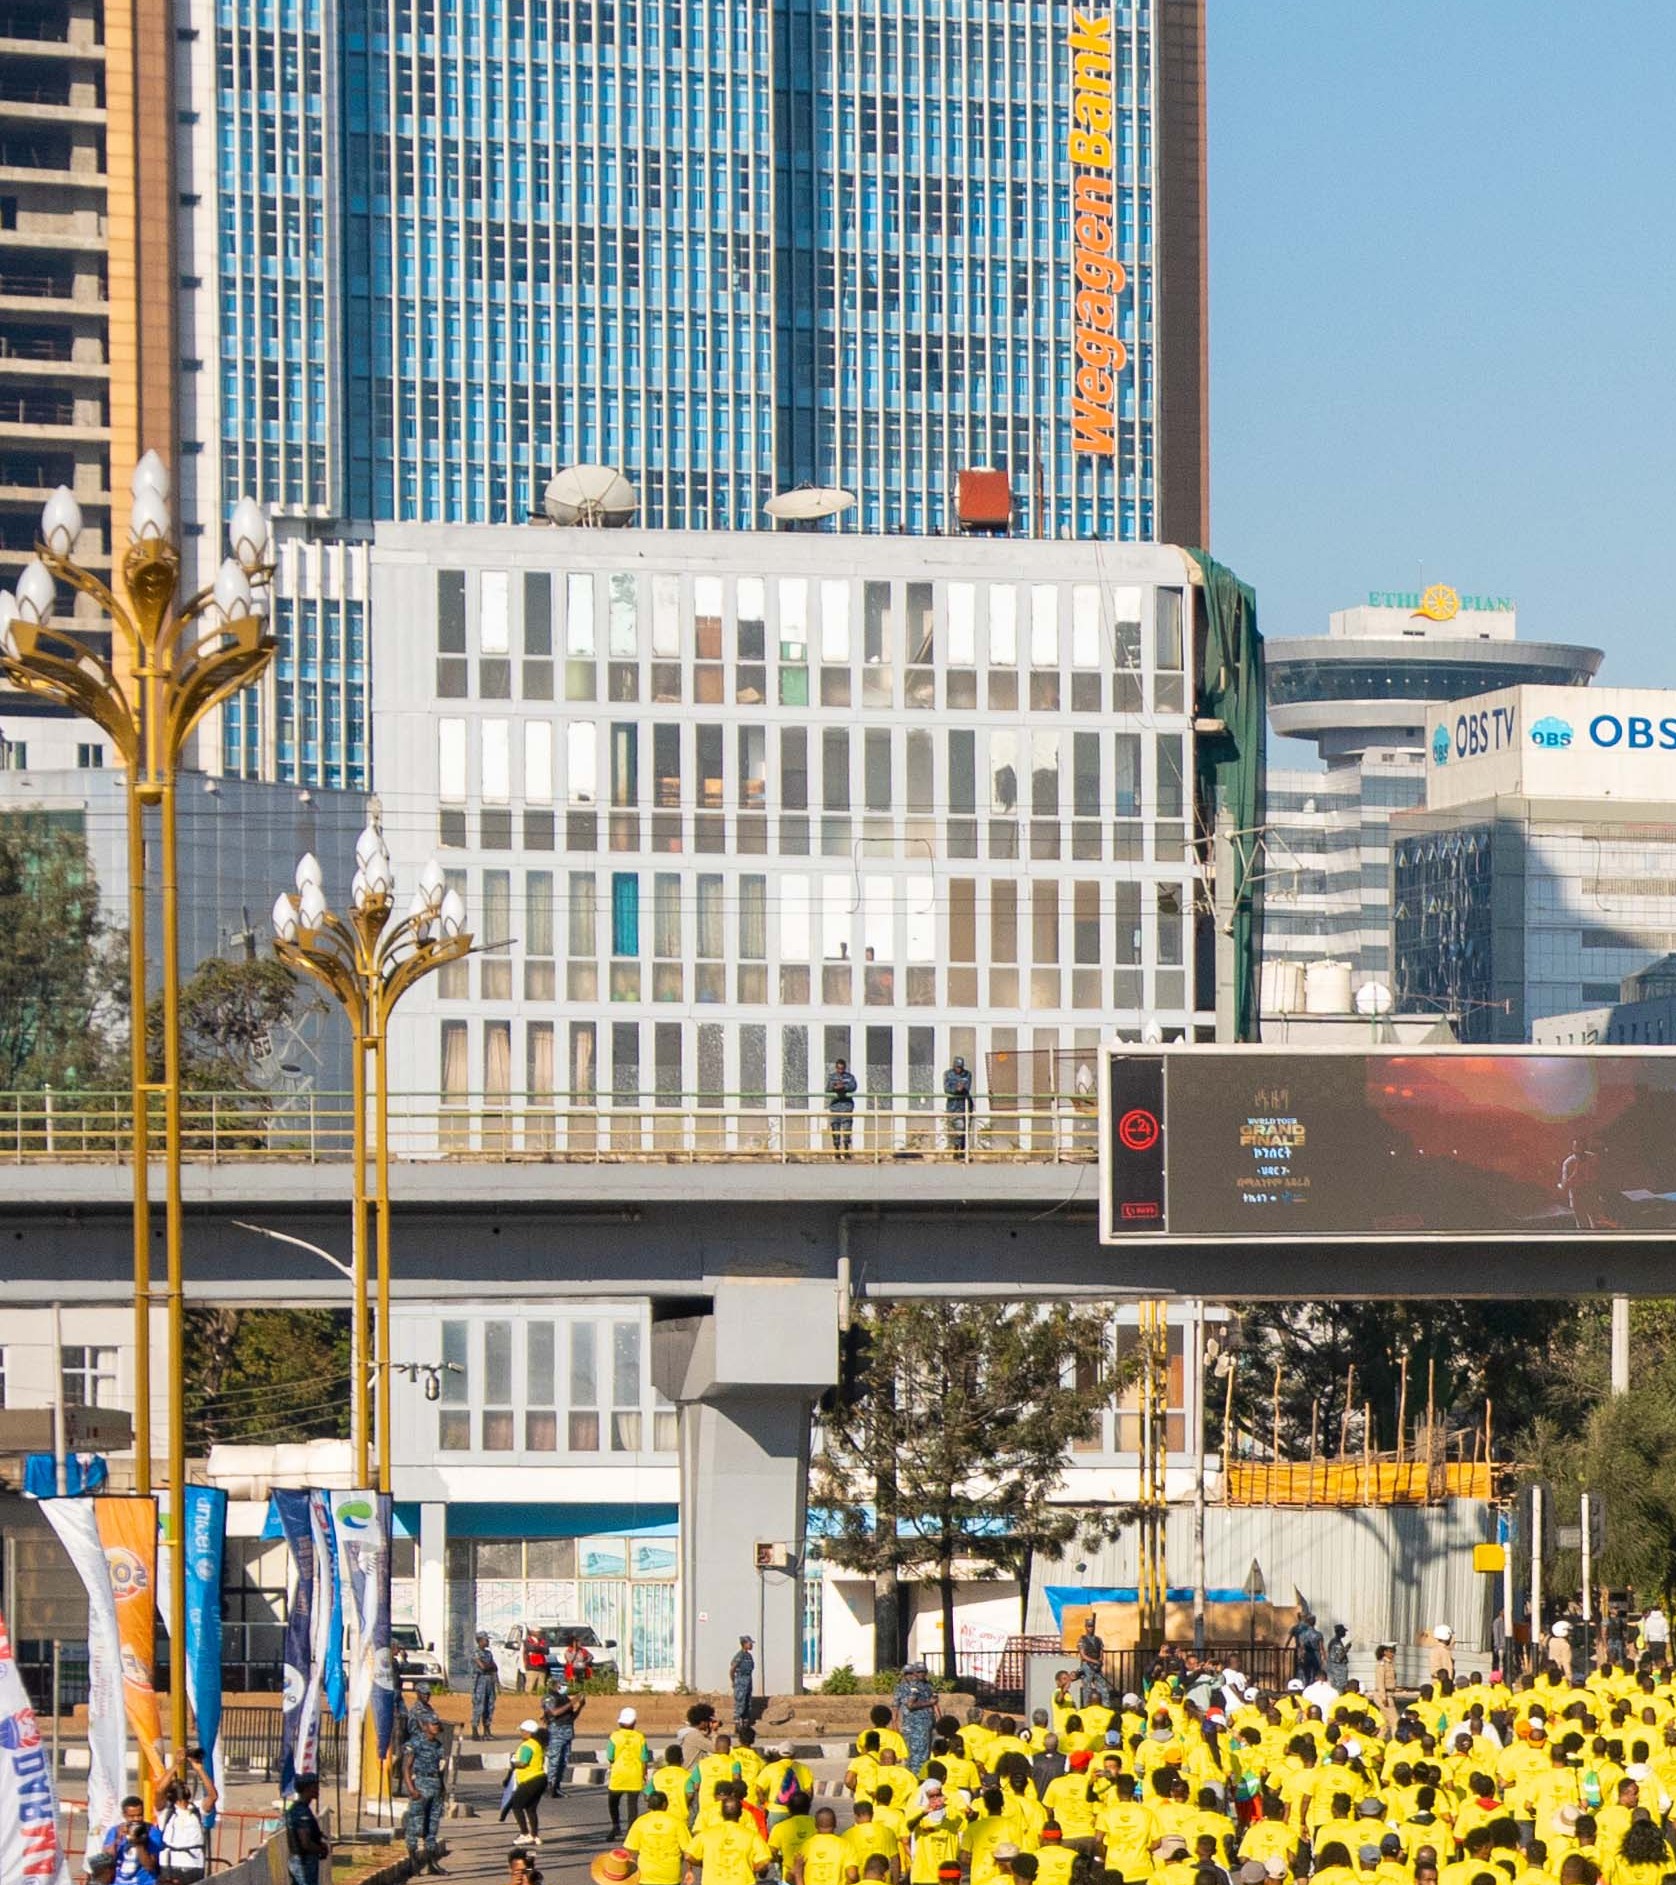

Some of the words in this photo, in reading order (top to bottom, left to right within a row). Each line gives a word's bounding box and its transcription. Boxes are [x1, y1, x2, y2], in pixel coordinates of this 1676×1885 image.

[1068, 7, 1113, 168] Bank
[1071, 173, 1126, 455] Wegagen
[1456, 710, 1488, 758] OBS
[1492, 706, 1515, 750] TV
[1532, 731, 1572, 746] OBS
[1240, 1124, 1305, 1135] GRAND
[1240, 1135, 1305, 1146] FINALE
[195, 1497, 213, 1553] unicef
